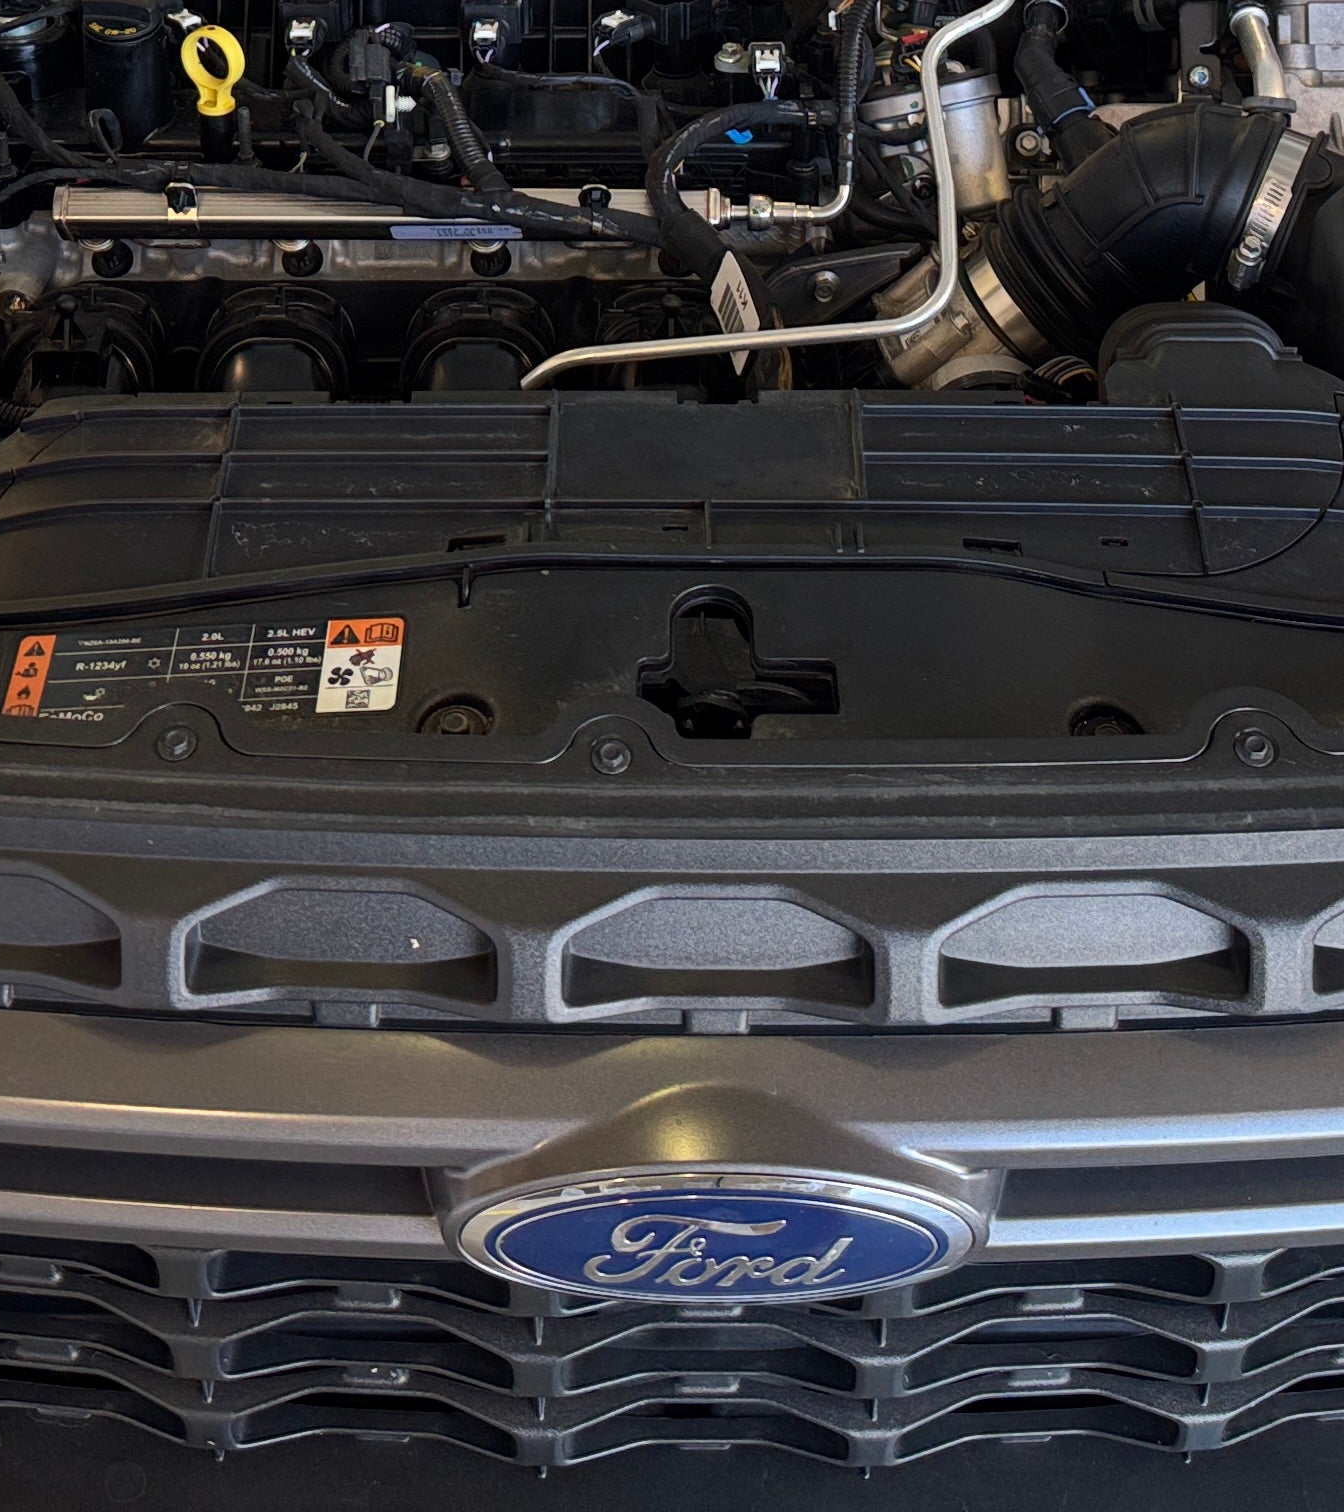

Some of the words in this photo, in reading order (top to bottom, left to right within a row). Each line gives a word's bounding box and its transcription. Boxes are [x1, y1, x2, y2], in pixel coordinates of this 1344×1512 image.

[201, 632, 225, 642] 2.0L
[292, 627, 317, 637] HEV
[190, 652, 218, 662] 0.550
[219, 651, 233, 662] kg
[268, 647, 295, 657] 0.500
[296, 646, 310, 657] kg
[75, 660, 127, 672] R-1234yf
[582, 1213, 854, 1289] Ford
